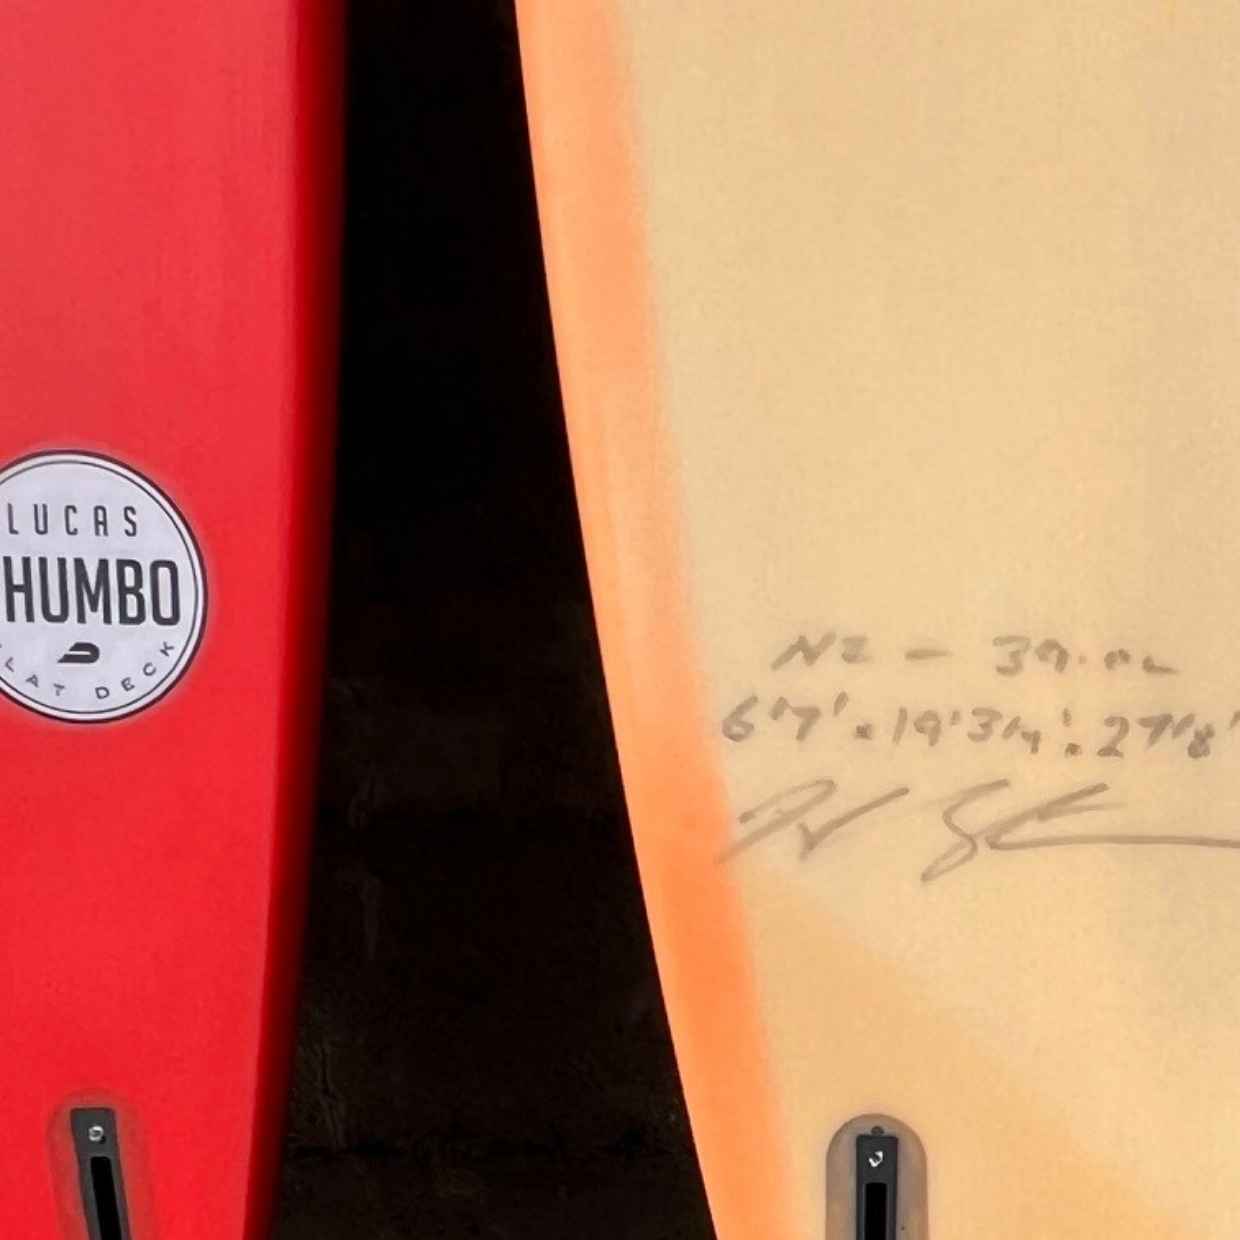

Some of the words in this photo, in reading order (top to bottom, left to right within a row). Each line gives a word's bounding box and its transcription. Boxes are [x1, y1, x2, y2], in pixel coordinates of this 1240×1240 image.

[7, 502, 138, 538] LUCAS
[1, 555, 181, 626] HUMBO
[0, 642, 65, 696] LAT
[95, 641, 175, 700] DECK
